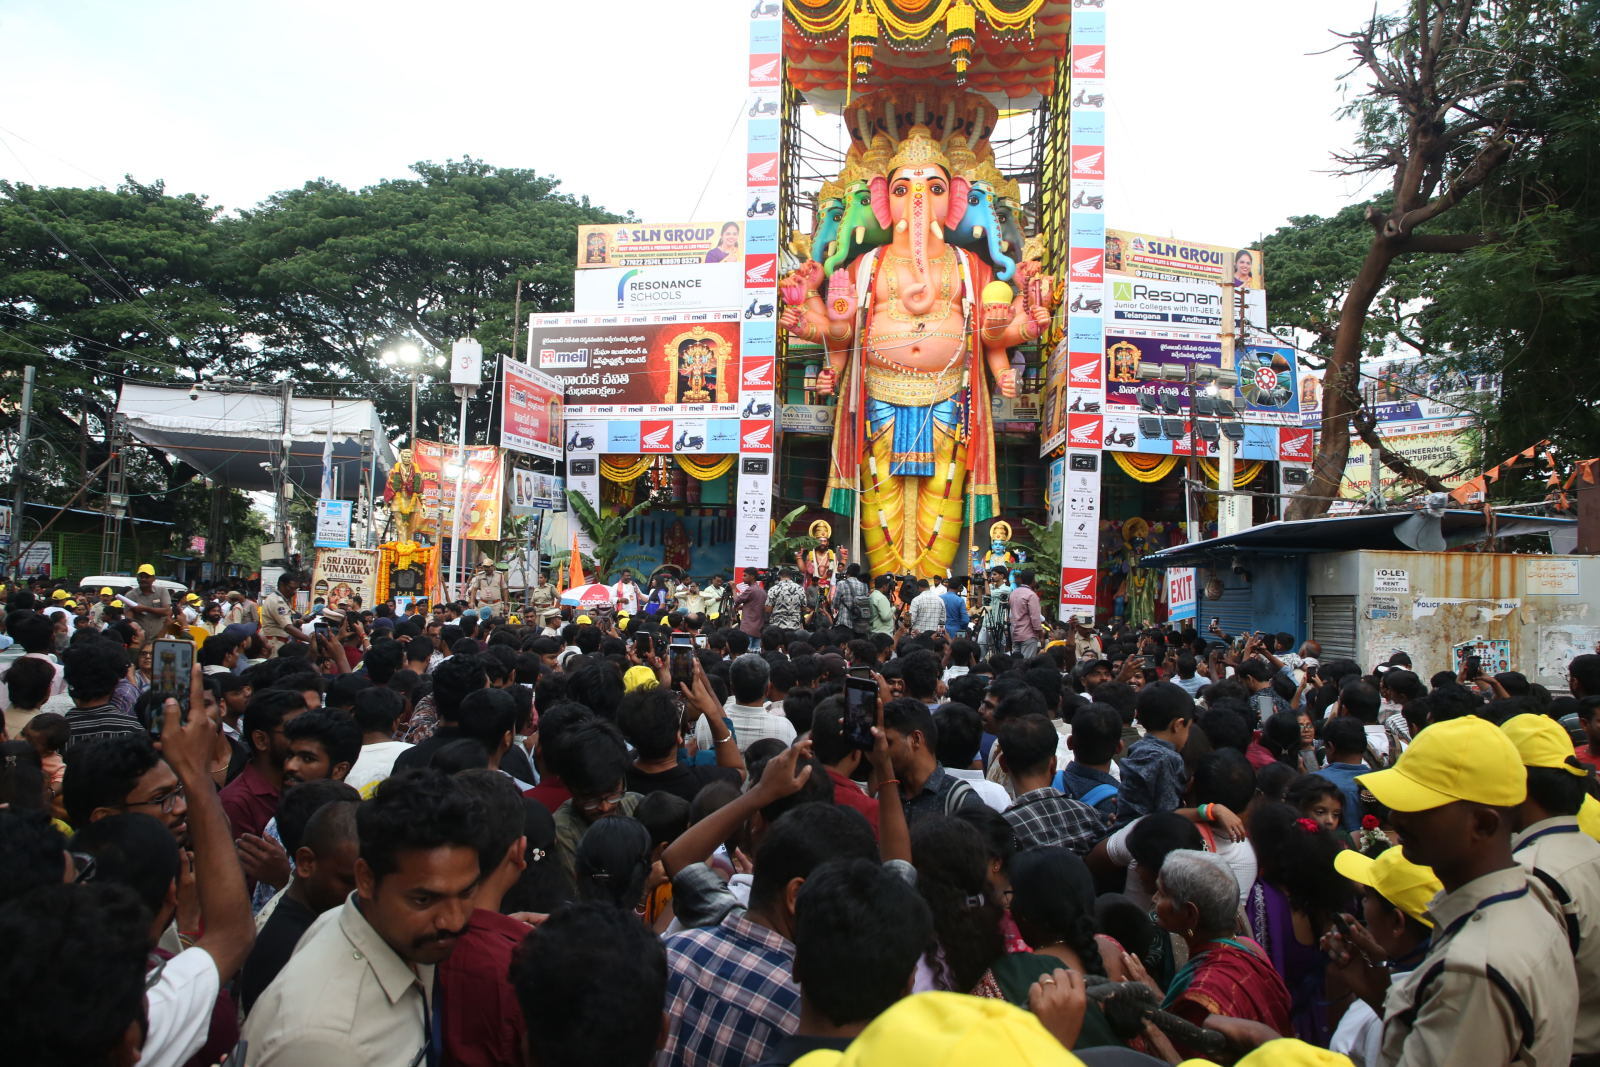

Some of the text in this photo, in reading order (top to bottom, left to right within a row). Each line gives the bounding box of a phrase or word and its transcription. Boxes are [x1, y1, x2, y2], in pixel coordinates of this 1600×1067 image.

[632, 228, 715, 242] SLN GROUP
[1148, 241, 1177, 258] SLN
[1180, 247, 1223, 265] GROU
[630, 279, 702, 291] RESONANCE
[630, 291, 682, 302] SCHOOLS
[1134, 285, 1242, 307] Resonane
[1140, 302, 1172, 311] Colleges
[1190, 306, 1213, 314] IIT-JEE
[1123, 312, 1161, 320] Telangana
[1181, 315, 1207, 324] Andhra
[557, 350, 587, 362] meil
[1281, 450, 1309, 458] HONDA
[326, 556, 367, 566] SRI SIDDI
[322, 564, 370, 575] VINAYAKA
[1377, 569, 1405, 577] TO-LET
[1171, 574, 1193, 604] EXIT
